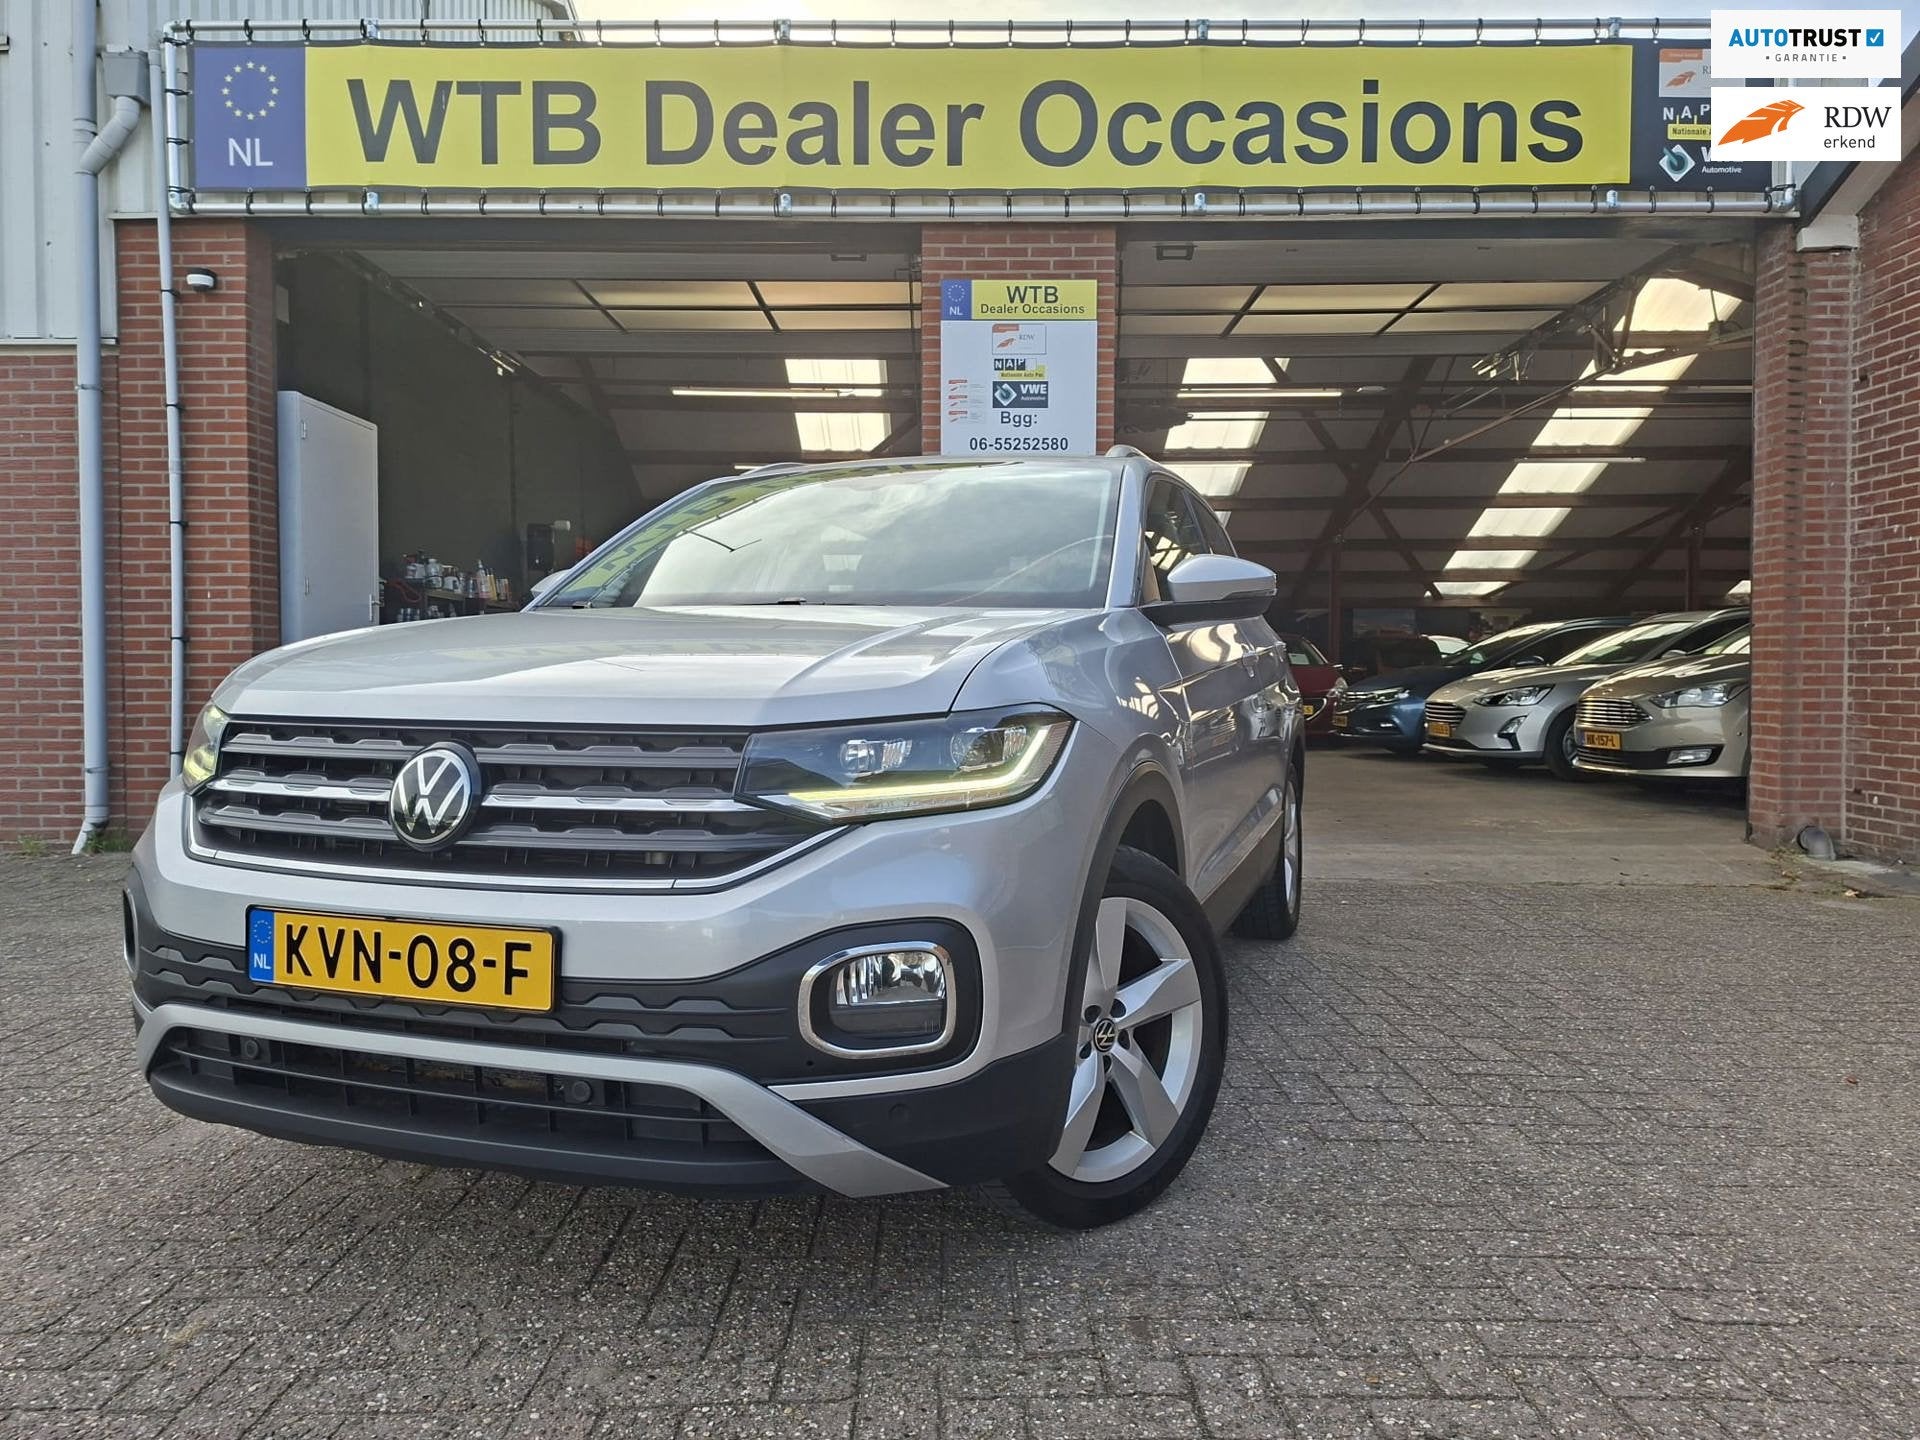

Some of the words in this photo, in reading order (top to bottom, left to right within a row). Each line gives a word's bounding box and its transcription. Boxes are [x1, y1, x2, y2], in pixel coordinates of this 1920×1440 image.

[346, 79, 601, 166] WTB
[645, 80, 985, 167] Dealer
[1019, 79, 1584, 168] Occasions
[1672, 127, 1707, 136] Nationale
[228, 138, 274, 168] NL
[1006, 286, 1059, 304] WTB
[949, 306, 963, 315] NL
[980, 303, 1018, 314] Dealer
[1022, 303, 1085, 314] Occasions
[1020, 384, 1047, 394] VWE
[1000, 411, 1038, 427] Bgg:
[969, 437, 1069, 450] 06-55252580
[254, 953, 271, 970] NL
[285, 923, 532, 996] KVN-08-F
